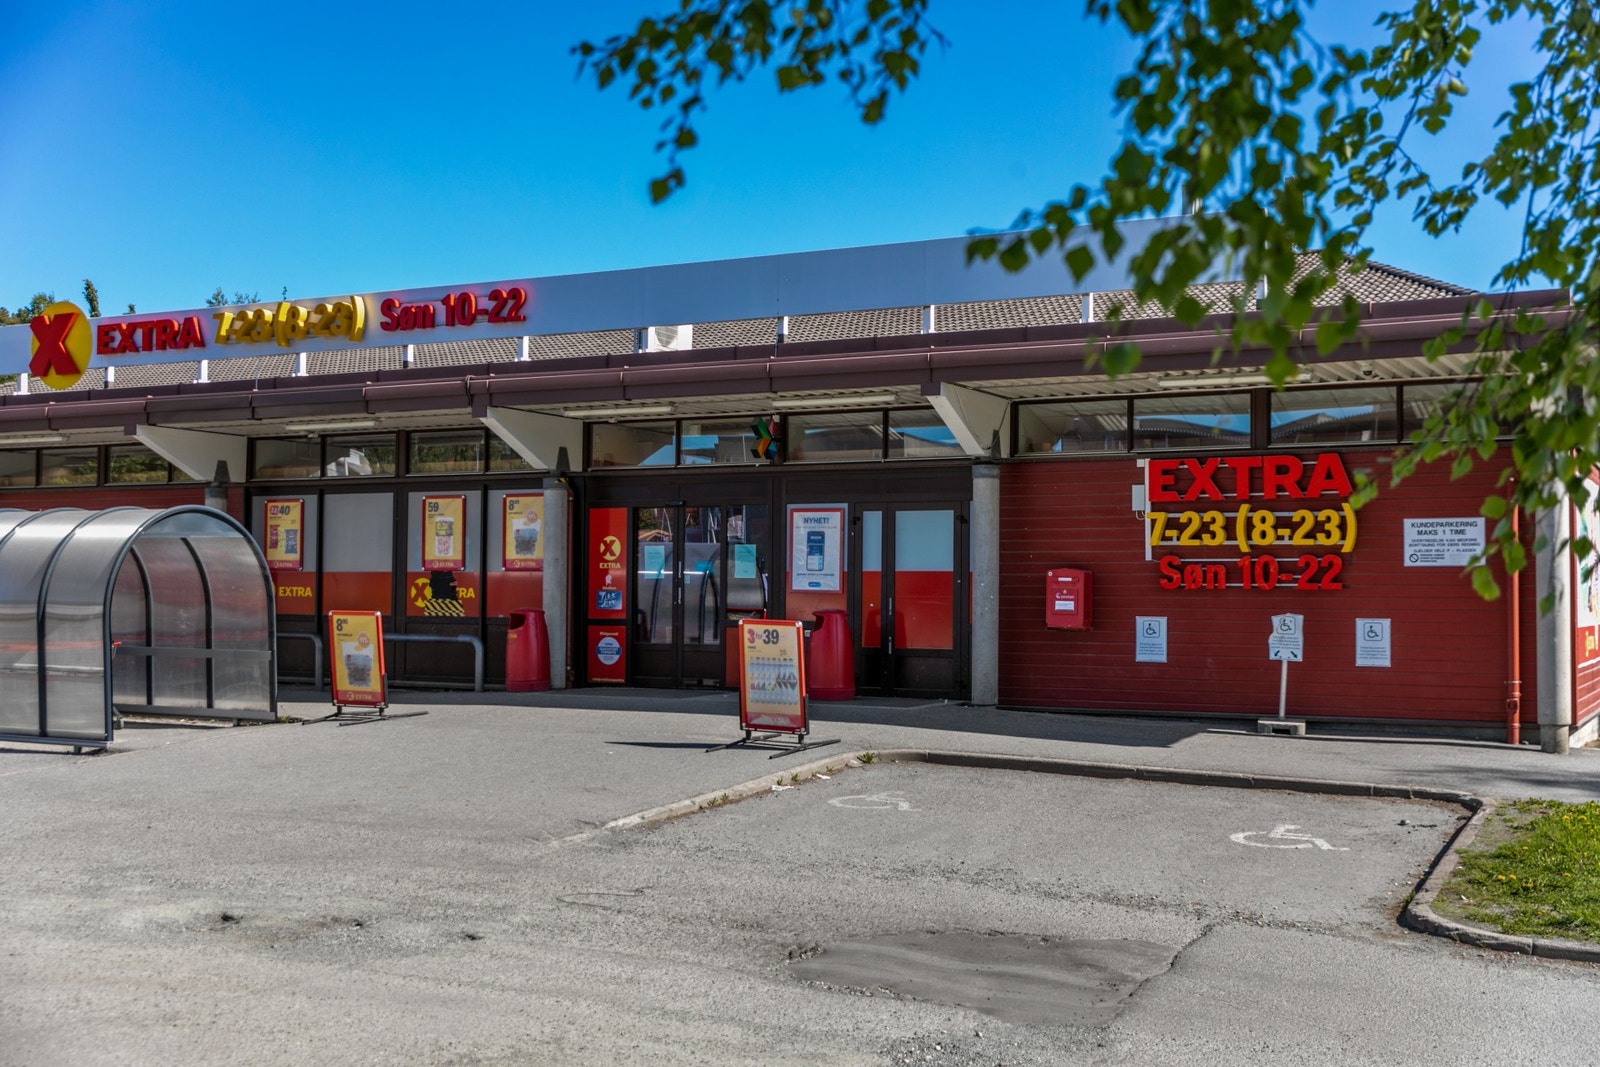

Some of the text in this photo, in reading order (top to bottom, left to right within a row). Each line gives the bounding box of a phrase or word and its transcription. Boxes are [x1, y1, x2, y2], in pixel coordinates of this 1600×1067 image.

[97, 316, 206, 355] EXTRA
[380, 298, 436, 332] Søn
[441, 287, 527, 327] 10-22
[1149, 453, 1353, 502] EXTRA
[427, 501, 439, 512] 59
[803, 517, 830, 525] NYHET!
[1147, 502, 1358, 553] 7-23 (8-23)
[1411, 521, 1478, 529] KUNDEPARKERING
[1160, 554, 1343, 591] Søn 10-22
[279, 586, 312, 597] EXTRA
[747, 628, 756, 645] 3
[763, 628, 780, 645] 39
